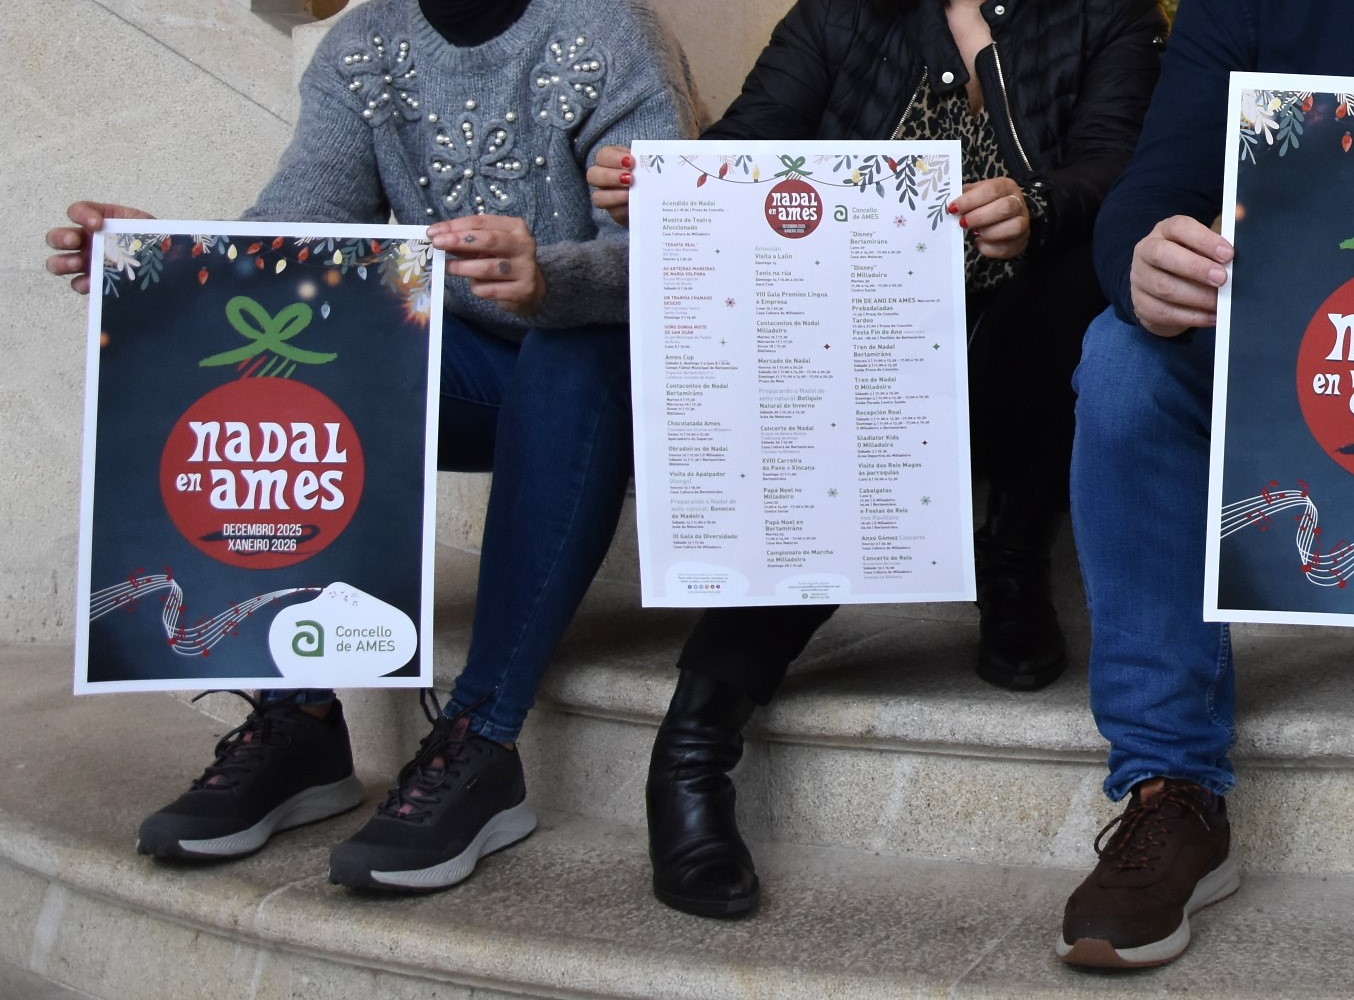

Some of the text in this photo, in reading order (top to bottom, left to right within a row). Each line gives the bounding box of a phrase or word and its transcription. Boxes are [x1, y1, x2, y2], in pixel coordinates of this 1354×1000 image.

[1312, 370, 1341, 396] en
[176, 472, 202, 492] en
[223, 523, 302, 537] DECEMBRO 2025
[228, 538, 297, 551] XANEIRO 2026
[336, 625, 392, 638] Concello
[336, 639, 396, 652] de AMES
